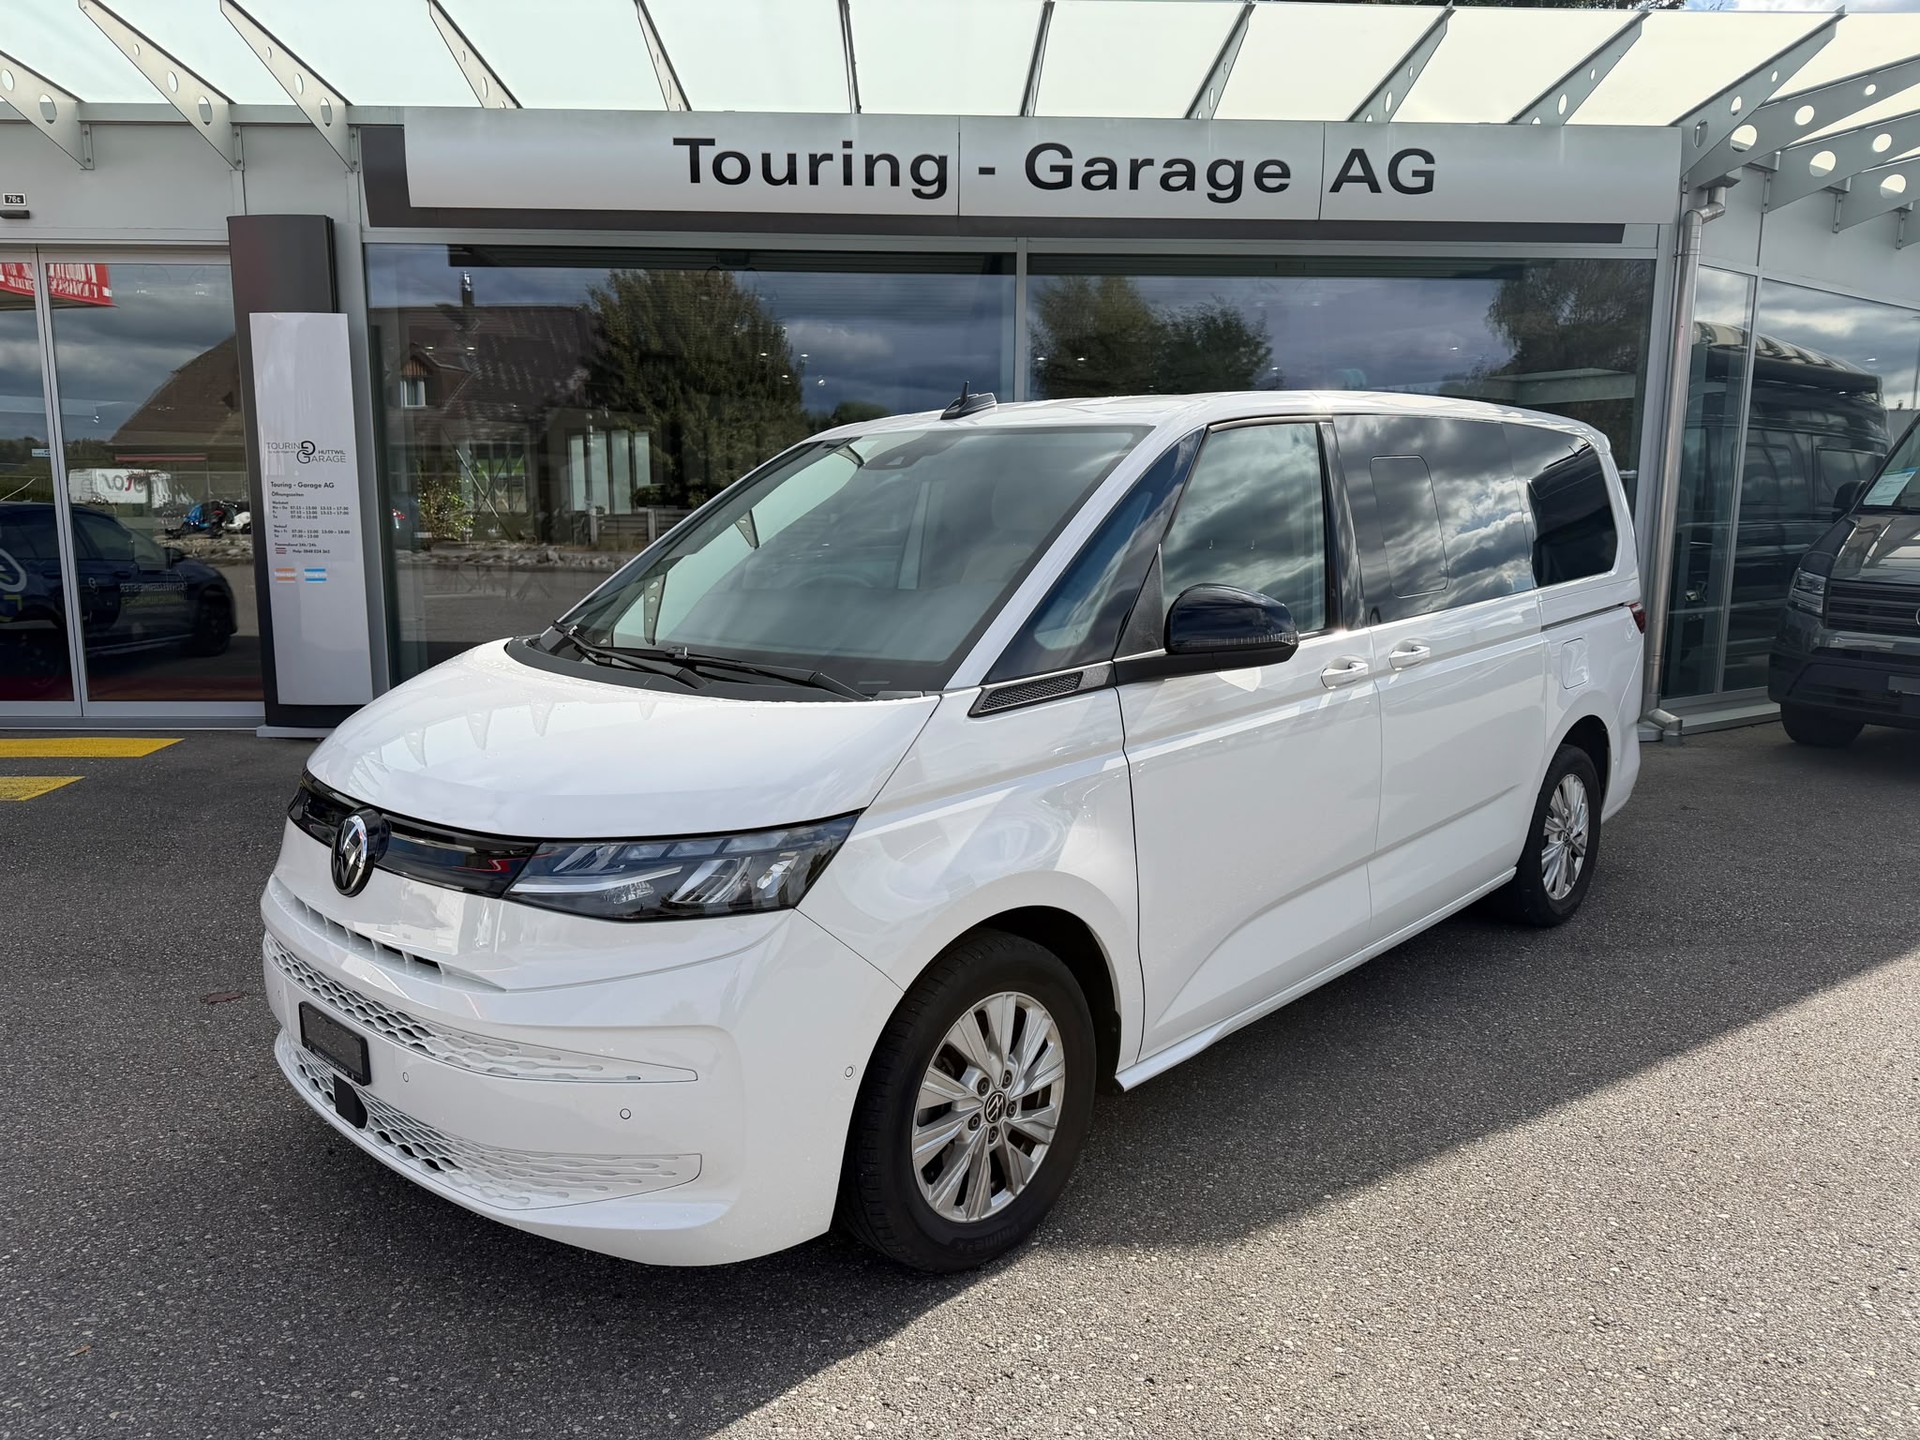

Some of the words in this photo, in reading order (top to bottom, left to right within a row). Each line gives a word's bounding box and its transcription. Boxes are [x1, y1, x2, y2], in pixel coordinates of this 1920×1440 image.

[672, 137, 949, 200] Touring
[977, 167, 996, 175] -
[1024, 142, 1292, 204] Garage
[1329, 147, 1437, 196] AG
[7, 195, 21, 203] 76c
[297, 449, 347, 464] GARAGE
[271, 481, 292, 489] Touring
